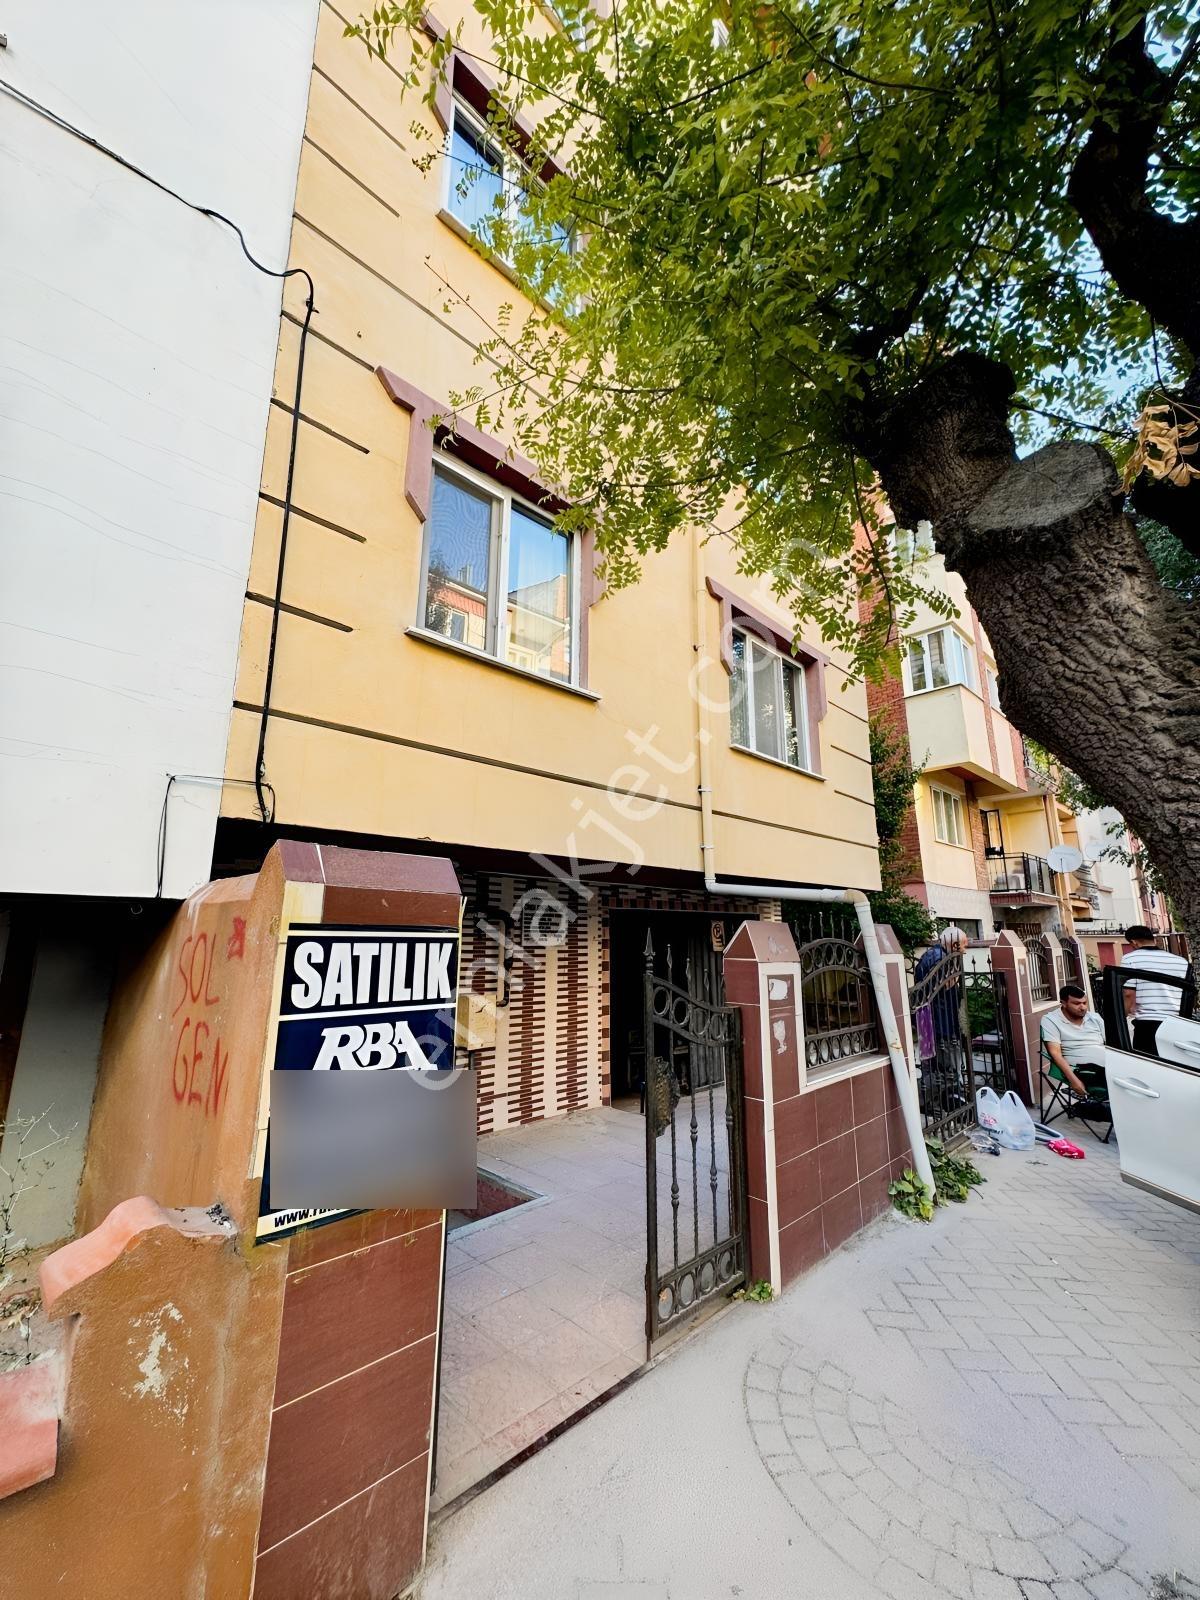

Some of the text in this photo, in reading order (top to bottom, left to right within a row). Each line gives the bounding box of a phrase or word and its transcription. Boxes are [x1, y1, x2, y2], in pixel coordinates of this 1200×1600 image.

[173, 932, 220, 1017] SOL
[290, 941, 454, 1009] SATILIK
[313, 1020, 439, 1070] RBA
